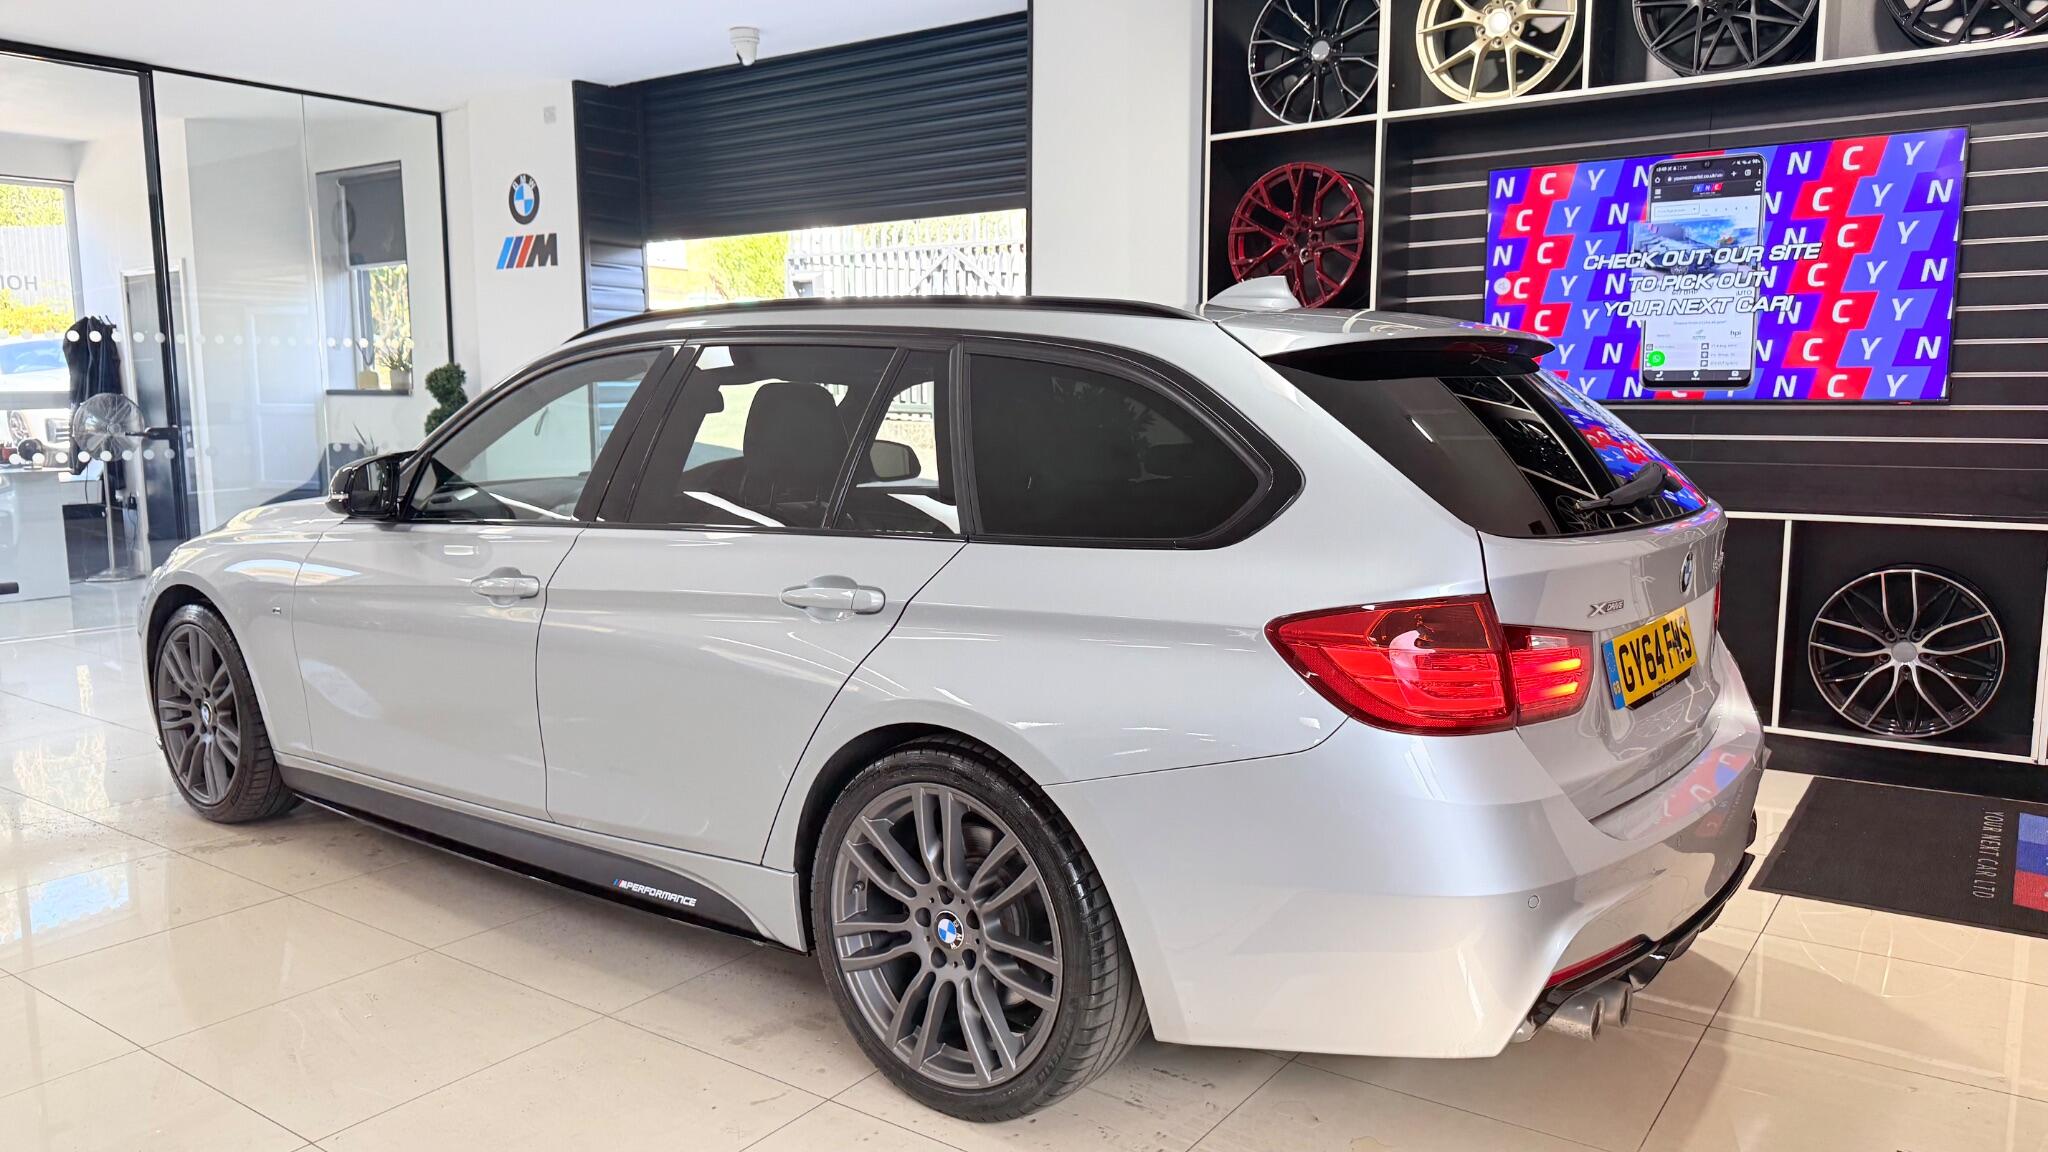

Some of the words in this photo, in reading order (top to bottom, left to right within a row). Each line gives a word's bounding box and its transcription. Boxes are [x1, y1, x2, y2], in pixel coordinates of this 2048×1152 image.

[512, 175, 536, 189] BMW
[1495, 176, 1515, 199] N
[1540, 172, 1557, 195] C
[1588, 169, 1605, 191] Y
[1787, 150, 1811, 175] N
[1842, 146, 1864, 170] C
[1904, 141, 1926, 165] Y
[1516, 209, 1533, 231] C
[1564, 206, 1581, 228] Y
[1607, 202, 1629, 225] N
[1812, 187, 1833, 211] C
[1872, 183, 1894, 207] Y
[1926, 179, 1954, 204] N
[1493, 245, 1513, 266] N
[1537, 242, 1554, 264] C
[1837, 223, 1858, 247] C
[1897, 220, 1920, 244] Y
[1583, 251, 1659, 271] CHECK
[1662, 249, 1712, 267] OUT
[1713, 246, 1764, 264] OUR
[1768, 242, 1823, 262] SITE
[1513, 277, 1530, 298] C
[1561, 275, 1578, 296] Y
[1605, 273, 1626, 295] N
[1807, 263, 1829, 287] C
[1866, 260, 1888, 284] Y
[1920, 258, 1947, 282] N
[1629, 275, 1656, 292] TO
[1660, 273, 1716, 291] PICK
[1717, 270, 1769, 289] OUT
[1534, 310, 1552, 331] C
[1582, 308, 1599, 330] Y
[1832, 299, 1853, 323] C
[1892, 297, 1914, 321] Y
[1604, 299, 1664, 317] YOUR
[1666, 297, 1734, 316] NEXT
[1736, 294, 1795, 313] CAR!
[1558, 343, 1575, 365] Y
[1601, 342, 1623, 364] N
[1803, 337, 1824, 361] C
[1861, 337, 1883, 360] Y
[1914, 336, 1941, 360] N
[1773, 375, 1797, 398] N
[1827, 374, 1848, 398] C
[1886, 374, 1908, 398] Y
[1619, 629, 1666, 693] GY64
[1983, 811, 2004, 832] YOUR
[1979, 834, 2001, 857] NEXT
[1976, 858, 1999, 877] CAR
[625, 881, 697, 907] PERFORMANCE
[1973, 879, 1996, 899] LTD
